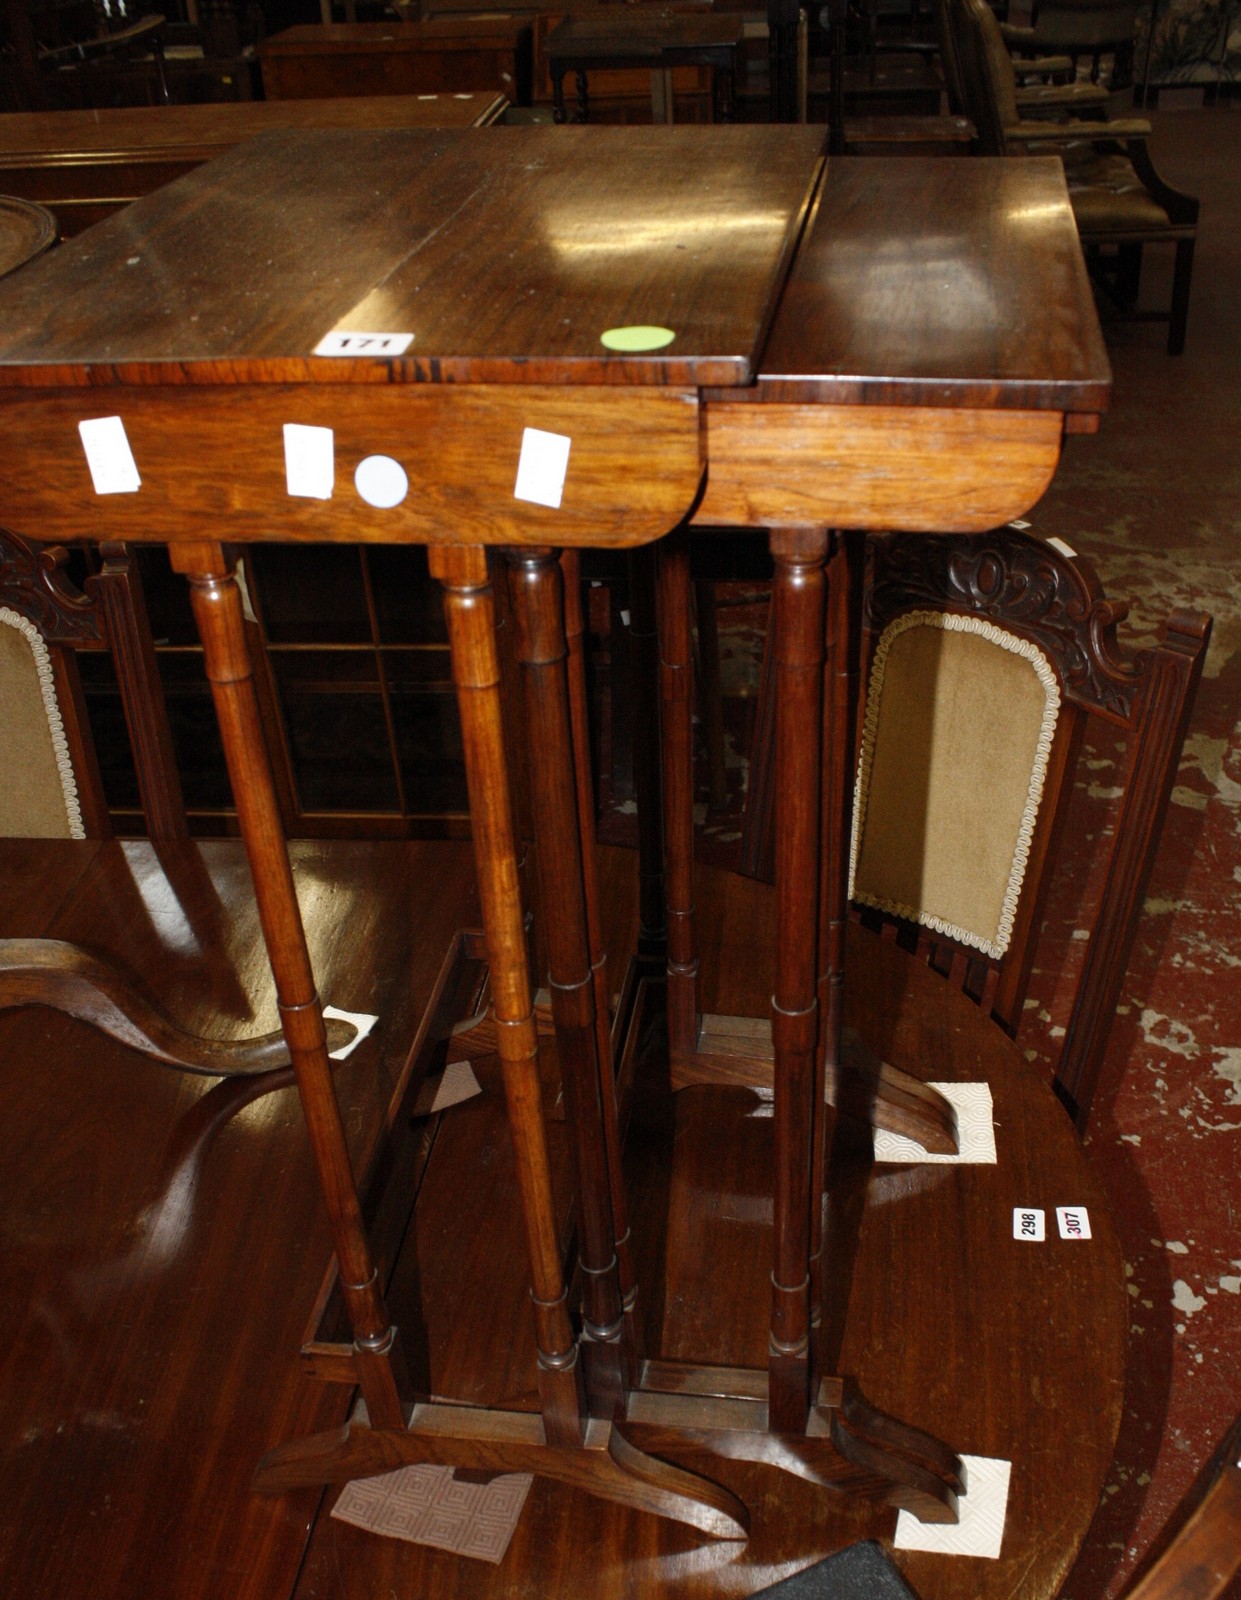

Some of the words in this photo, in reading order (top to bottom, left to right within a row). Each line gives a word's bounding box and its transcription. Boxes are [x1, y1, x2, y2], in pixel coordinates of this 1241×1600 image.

[338, 337, 392, 349] 171
[1021, 1213, 1036, 1236] 298
[1064, 1212, 1083, 1235] 307
